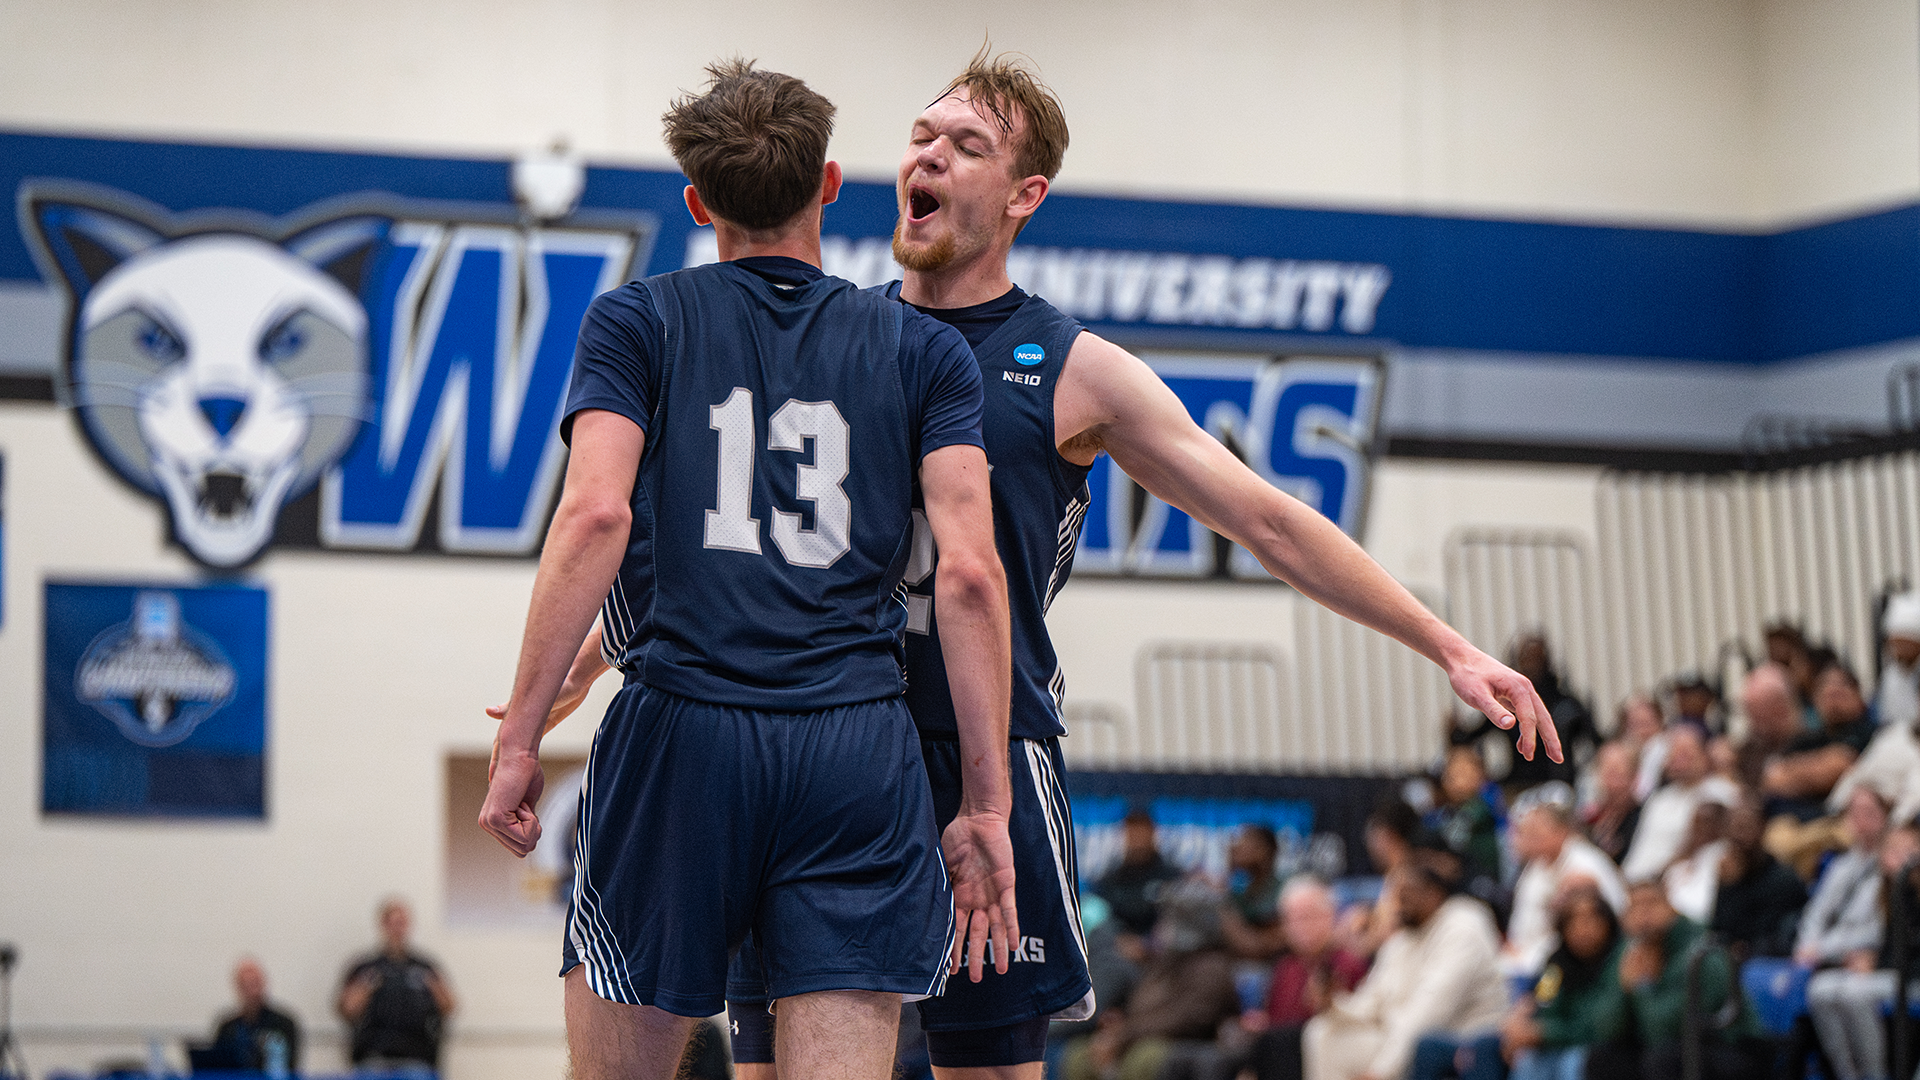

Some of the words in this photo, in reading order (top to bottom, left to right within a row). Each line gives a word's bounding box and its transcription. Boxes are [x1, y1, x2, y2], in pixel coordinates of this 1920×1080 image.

[1017, 352, 1042, 360] NCAA
[1002, 370, 1041, 386] NE10
[703, 387, 851, 569] 13
